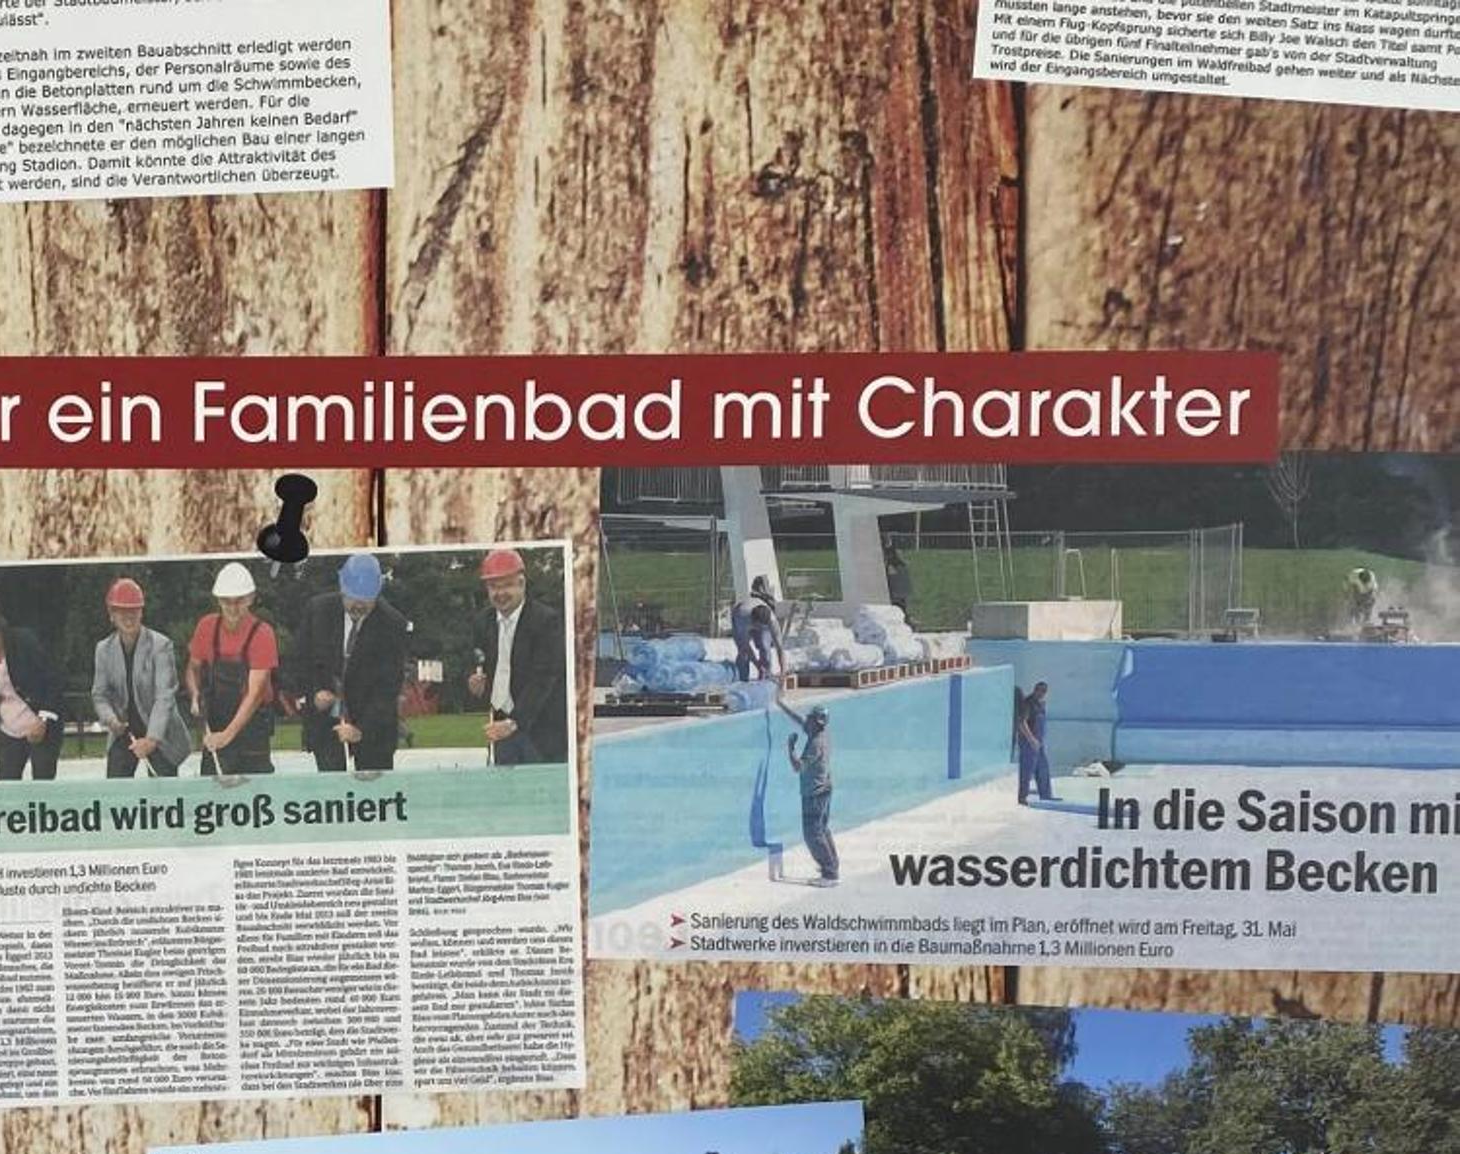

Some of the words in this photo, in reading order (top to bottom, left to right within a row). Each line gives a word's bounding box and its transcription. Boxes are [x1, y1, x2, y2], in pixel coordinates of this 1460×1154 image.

[53, 47, 71, 60] im
[75, 46, 132, 60] zweiten
[136, 42, 232, 57] Bauabschnitt
[236, 39, 293, 56] erledigt
[297, 37, 351, 52] werden
[989, 59, 1016, 71] wird
[1019, 60, 1042, 73] der
[7, 176, 66, 191] werden,
[70, 173, 101, 188] sind
[105, 173, 128, 187] die
[131, 169, 256, 186] Verantwortlichen
[48, 381, 160, 442] ein
[194, 378, 681, 442] Familienbad
[713, 377, 830, 439] mit
[858, 375, 1250, 438] Charakter
[108, 796, 185, 830] wird
[188, 793, 275, 835] groß
[283, 790, 408, 825] saniert
[1096, 787, 1141, 830] In
[1152, 787, 1225, 832] die
[1235, 788, 1395, 834] Saison
[5, 867, 68, 879] investieren
[68, 863, 86, 879] 1,3
[88, 863, 140, 876] Millionen
[141, 861, 168, 875] Euro
[888, 845, 1250, 891] wasserdichtem
[1264, 848, 1437, 894] Becken
[27, 882, 60, 896] durch
[62, 880, 112, 894] undichte
[113, 879, 156, 893] Becken
[690, 912, 769, 933] Sanierung
[770, 913, 799, 930] des
[802, 914, 950, 935] Waldschwimmbads
[952, 916, 985, 937] liegt
[988, 916, 1009, 933] im
[1011, 917, 1050, 935] Plan,
[1052, 918, 1114, 934] eröffnet
[1117, 919, 1151, 935] wird
[1153, 921, 1178, 935] am
[1268, 921, 1296, 937] Mai
[689, 935, 777, 952] Stadtwerke
[873, 937, 888, 953] in
[890, 938, 915, 954] die
[917, 938, 1036, 956] Baumaßnahme
[1038, 939, 1061, 957] 1,3
[1064, 940, 1135, 957] Millionen
[1138, 941, 1174, 957] Euro
